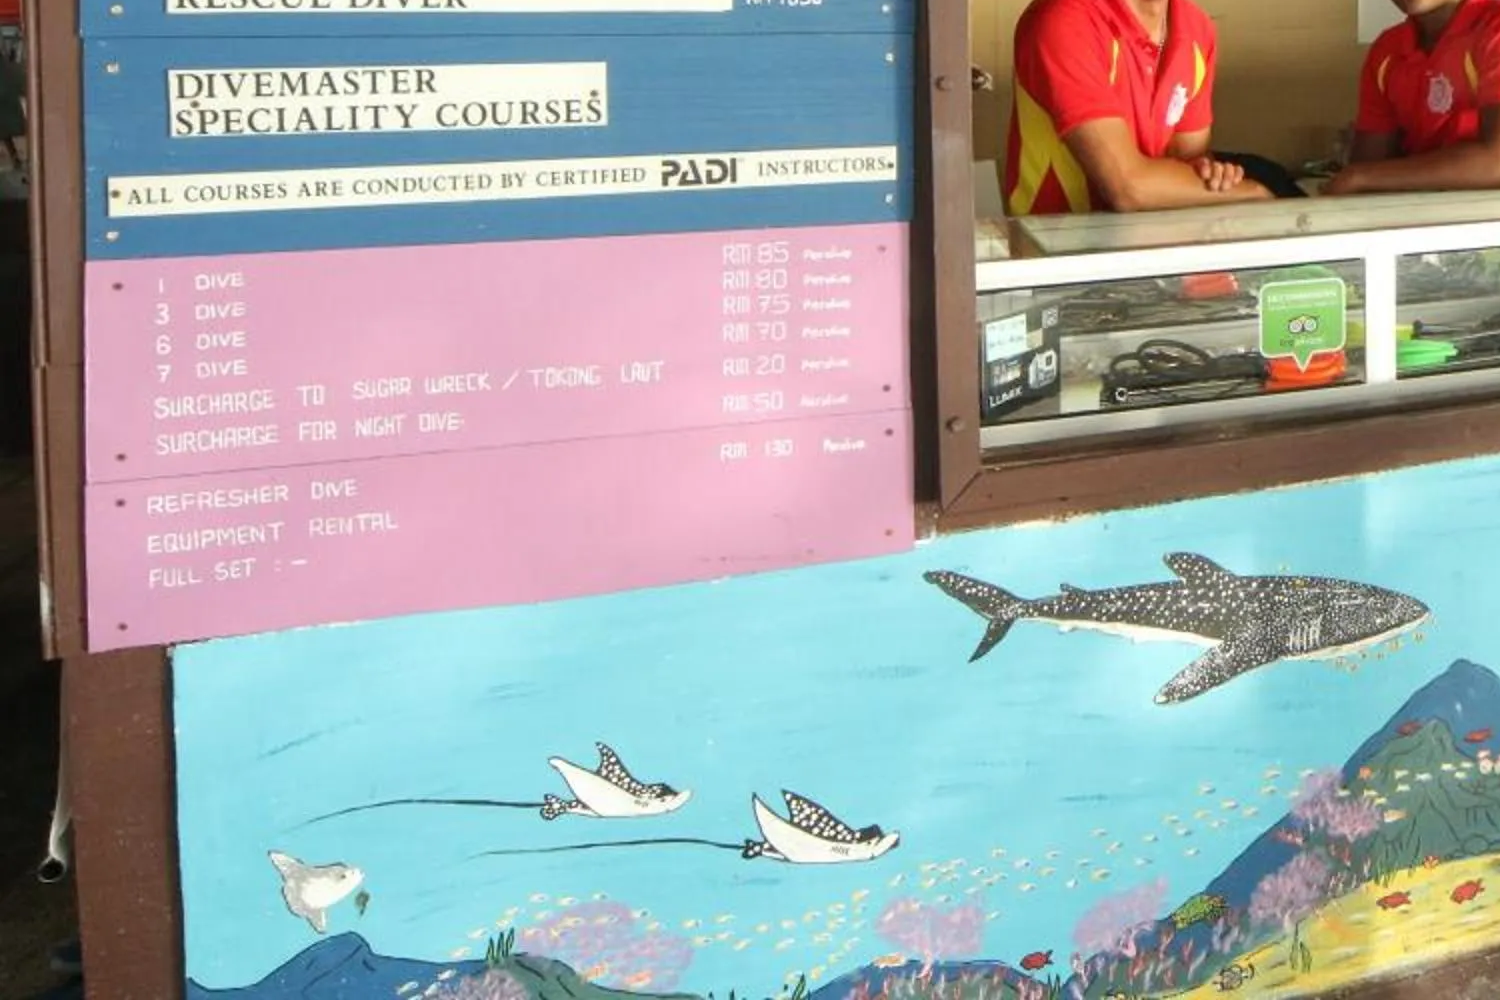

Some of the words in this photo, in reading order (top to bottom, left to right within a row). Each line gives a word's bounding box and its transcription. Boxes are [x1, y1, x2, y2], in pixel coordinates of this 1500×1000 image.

[175, 69, 437, 100] DIVEMASTER
[175, 103, 420, 136] SPECIALITY
[435, 99, 602, 128] COURSES
[128, 187, 173, 205] ALL
[183, 183, 288, 203] COURSES
[297, 180, 343, 198] ARE
[352, 174, 493, 195] CONDUCTED
[501, 172, 526, 189] BY
[536, 167, 647, 187] CERTIFIED
[661, 158, 739, 187] PADI
[195, 272, 245, 291] DIVE
[155, 303, 170, 325] 3
[195, 302, 246, 321] DIVE
[156, 334, 172, 355] 6
[196, 331, 246, 350] DIVE
[156, 364, 172, 383] 7
[197, 359, 247, 379] DIVE
[755, 354, 785, 376] 20
[154, 389, 275, 419] SURCHARGE
[296, 384, 325, 407] TO
[352, 376, 411, 400] SUGAR
[424, 372, 492, 394] WRECK
[526, 364, 602, 390] TOKONG
[621, 360, 664, 384] LAUT
[753, 390, 783, 411] 50
[155, 424, 279, 456] SURCHARGE
[299, 420, 337, 441] FOR
[355, 414, 406, 438] NIGHT
[147, 484, 289, 515] REFRESHER
[311, 479, 358, 500] DIVE
[147, 522, 285, 554] EQUIPMENT
[309, 511, 399, 538] RENTAL
[148, 567, 201, 589] FULL
[214, 557, 256, 581] SET
